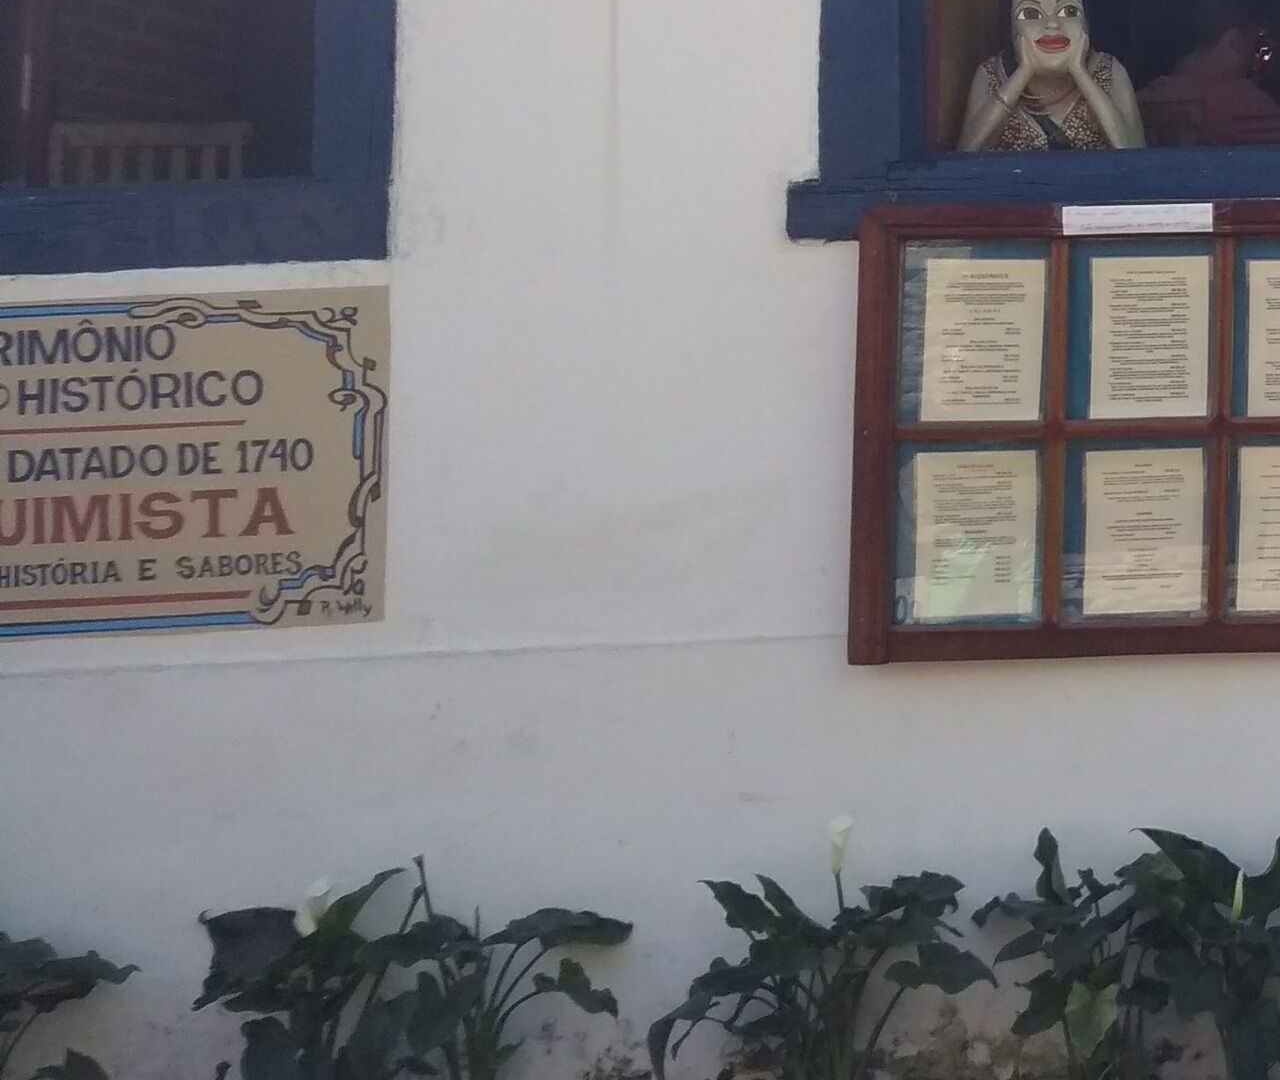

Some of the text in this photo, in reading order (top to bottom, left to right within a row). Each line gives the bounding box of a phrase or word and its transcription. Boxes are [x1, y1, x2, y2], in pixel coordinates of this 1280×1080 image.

[17, 369, 264, 416] HISTÓRICO
[7, 437, 314, 484] DATADO DE 1740
[0, 486, 296, 547] UIMISTA
[0, 551, 304, 589] HISTÓRIA E SABORES
